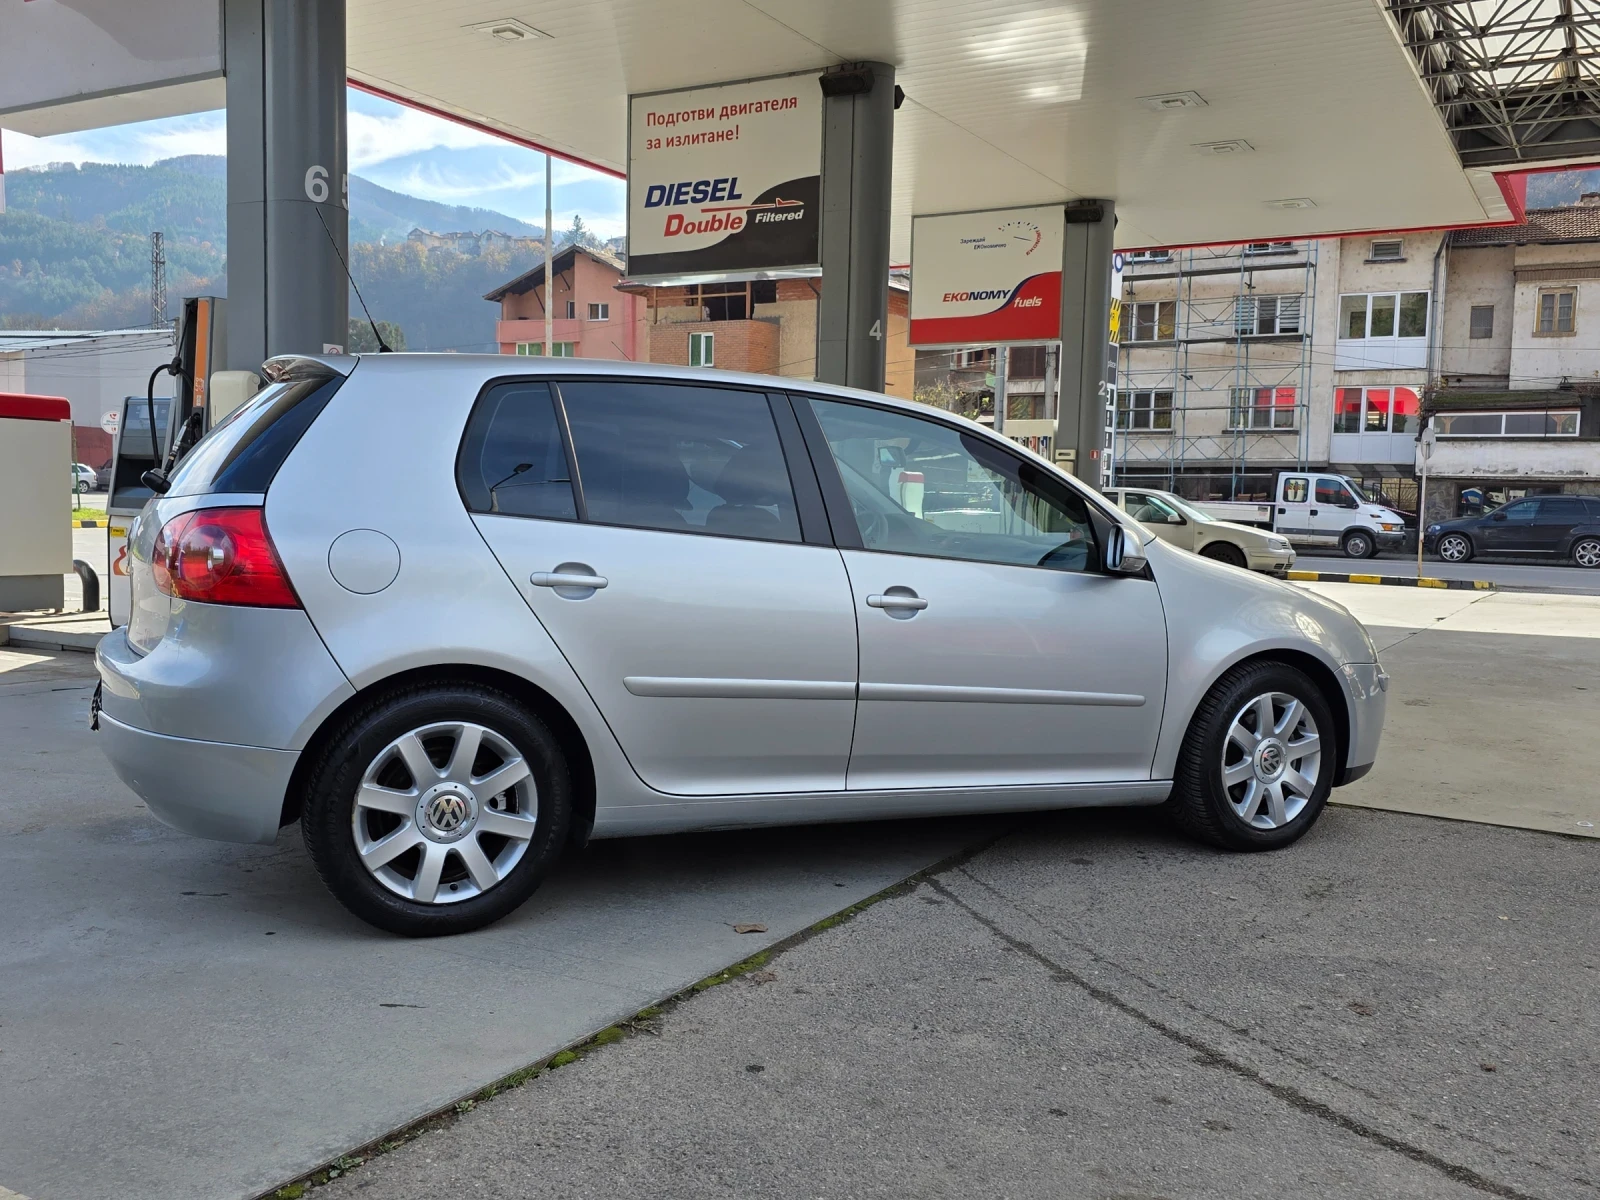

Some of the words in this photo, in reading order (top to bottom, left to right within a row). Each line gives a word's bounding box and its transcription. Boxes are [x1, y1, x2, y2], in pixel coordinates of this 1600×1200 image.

[646, 107, 715, 128] Подготви
[719, 97, 798, 121] двигателя
[646, 137, 661, 150] за
[666, 124, 740, 148] излитане!
[304, 165, 329, 203] 6
[644, 177, 743, 208] DIESEL
[664, 212, 743, 237] Double
[755, 209, 804, 223] Filtered
[942, 289, 1011, 303] EKONOMY
[1013, 296, 1043, 308] fuels
[869, 319, 882, 341] 4
[1097, 380, 1106, 396] 2
[430, 795, 465, 830] VW
